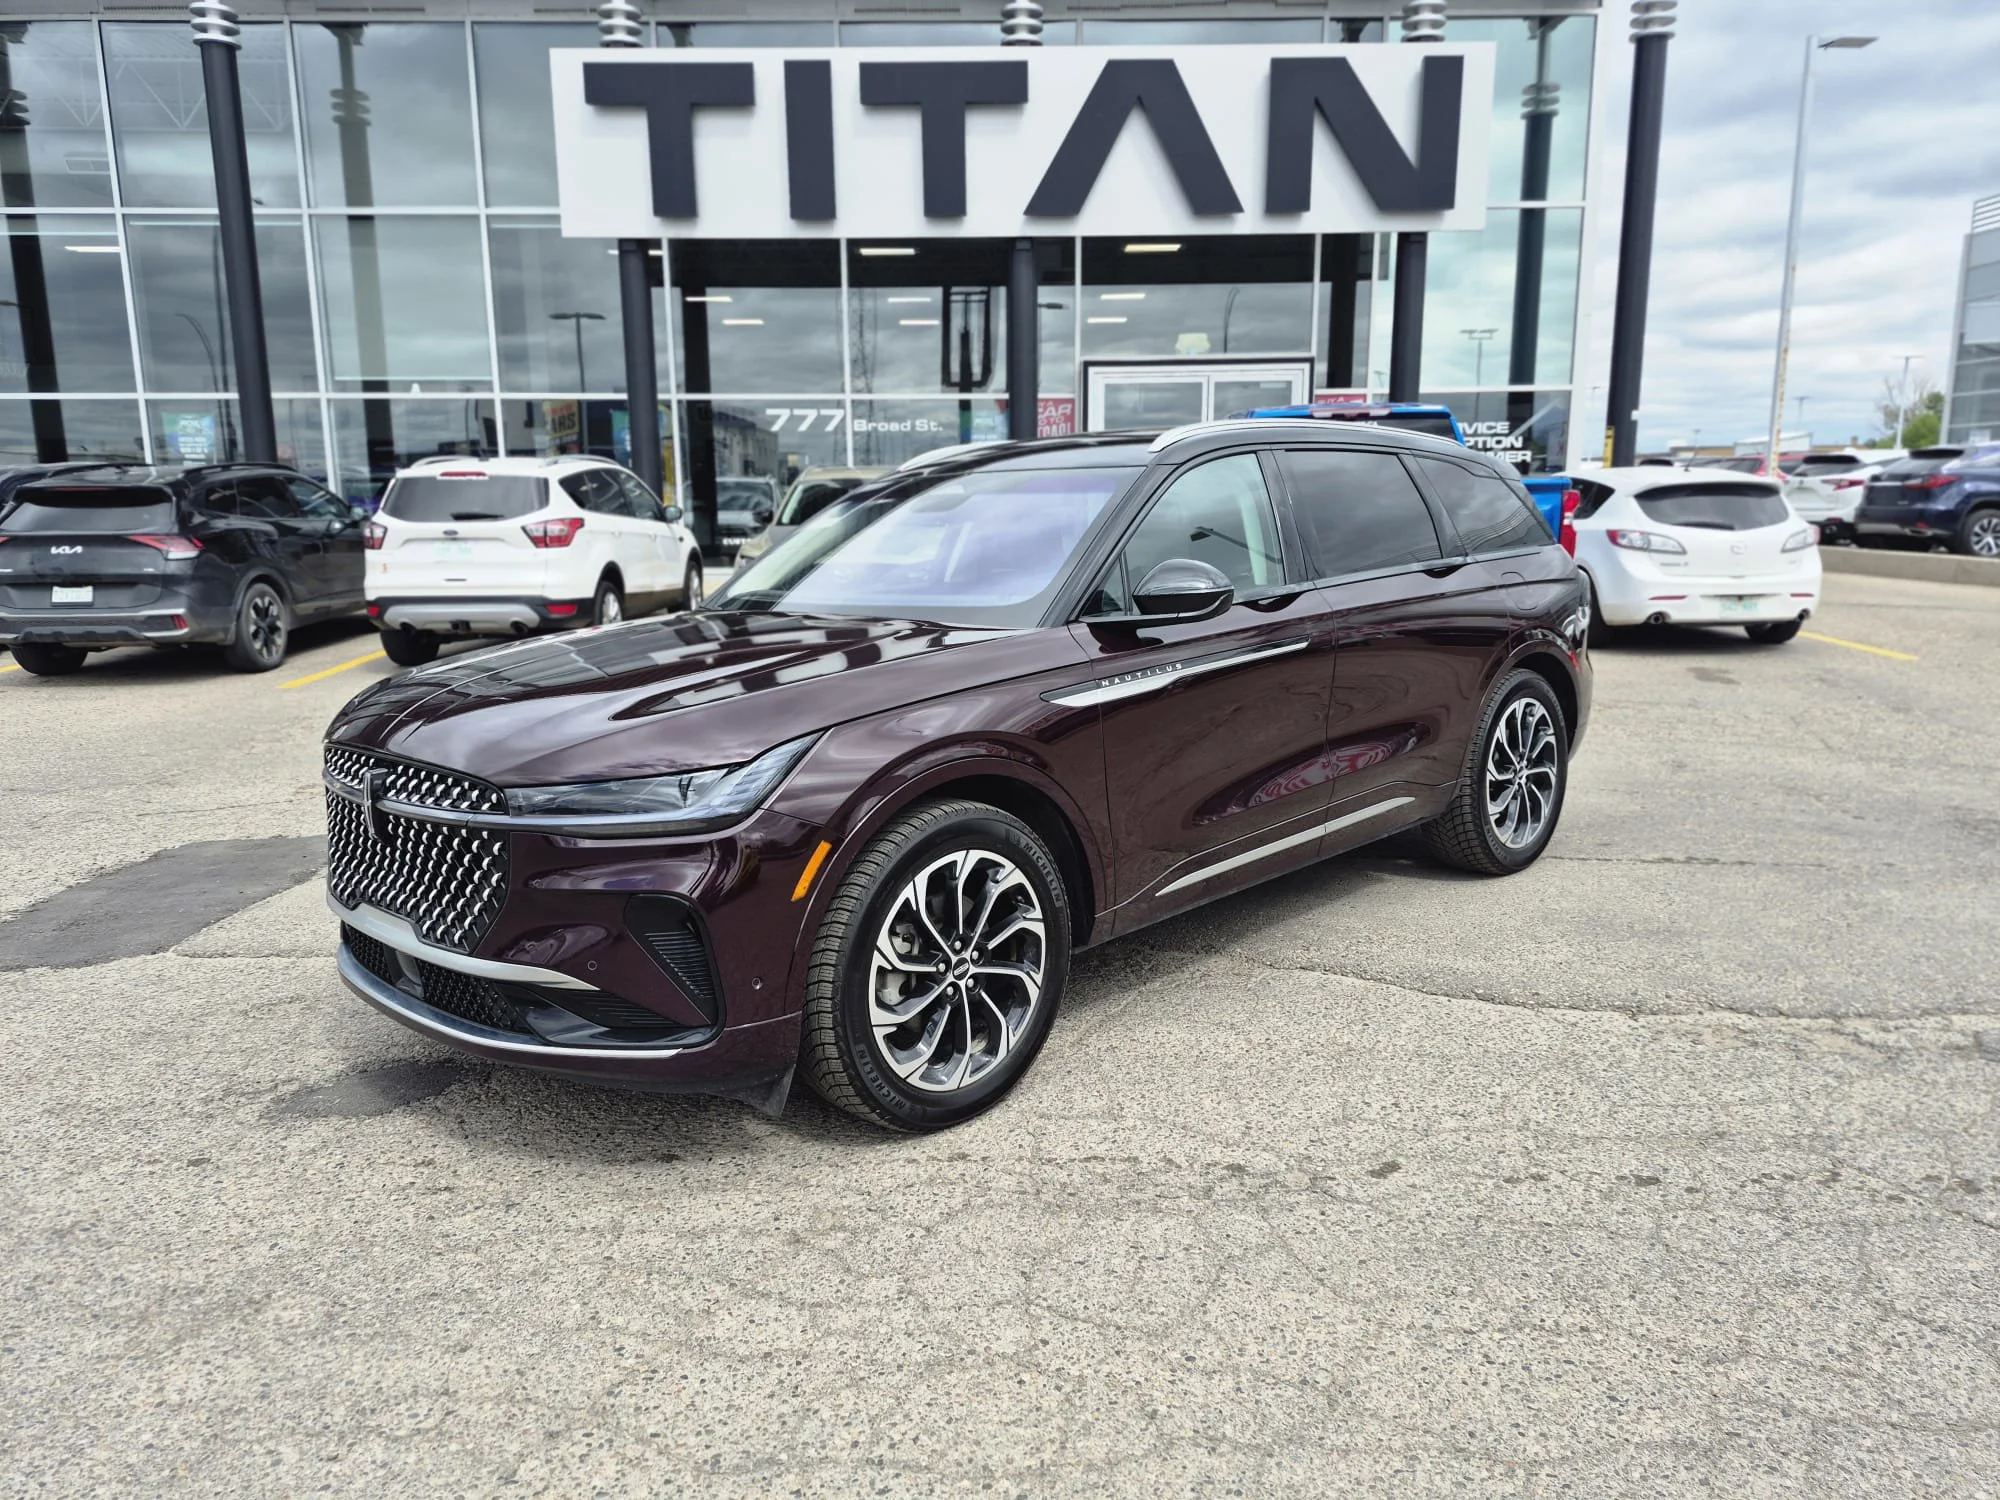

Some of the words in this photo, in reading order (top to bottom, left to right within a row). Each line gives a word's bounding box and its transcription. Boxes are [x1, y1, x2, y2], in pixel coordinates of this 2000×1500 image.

[582, 54, 1464, 220] TITAN
[765, 408, 845, 432] 777
[853, 419, 911, 432] Broad
[915, 419, 943, 432] St.
[50, 545, 83, 554] KIA
[1101, 662, 1183, 688] NAUTILUS
[1022, 842, 1063, 904] MICHELIN
[857, 1048, 917, 1110] MICHELIN
